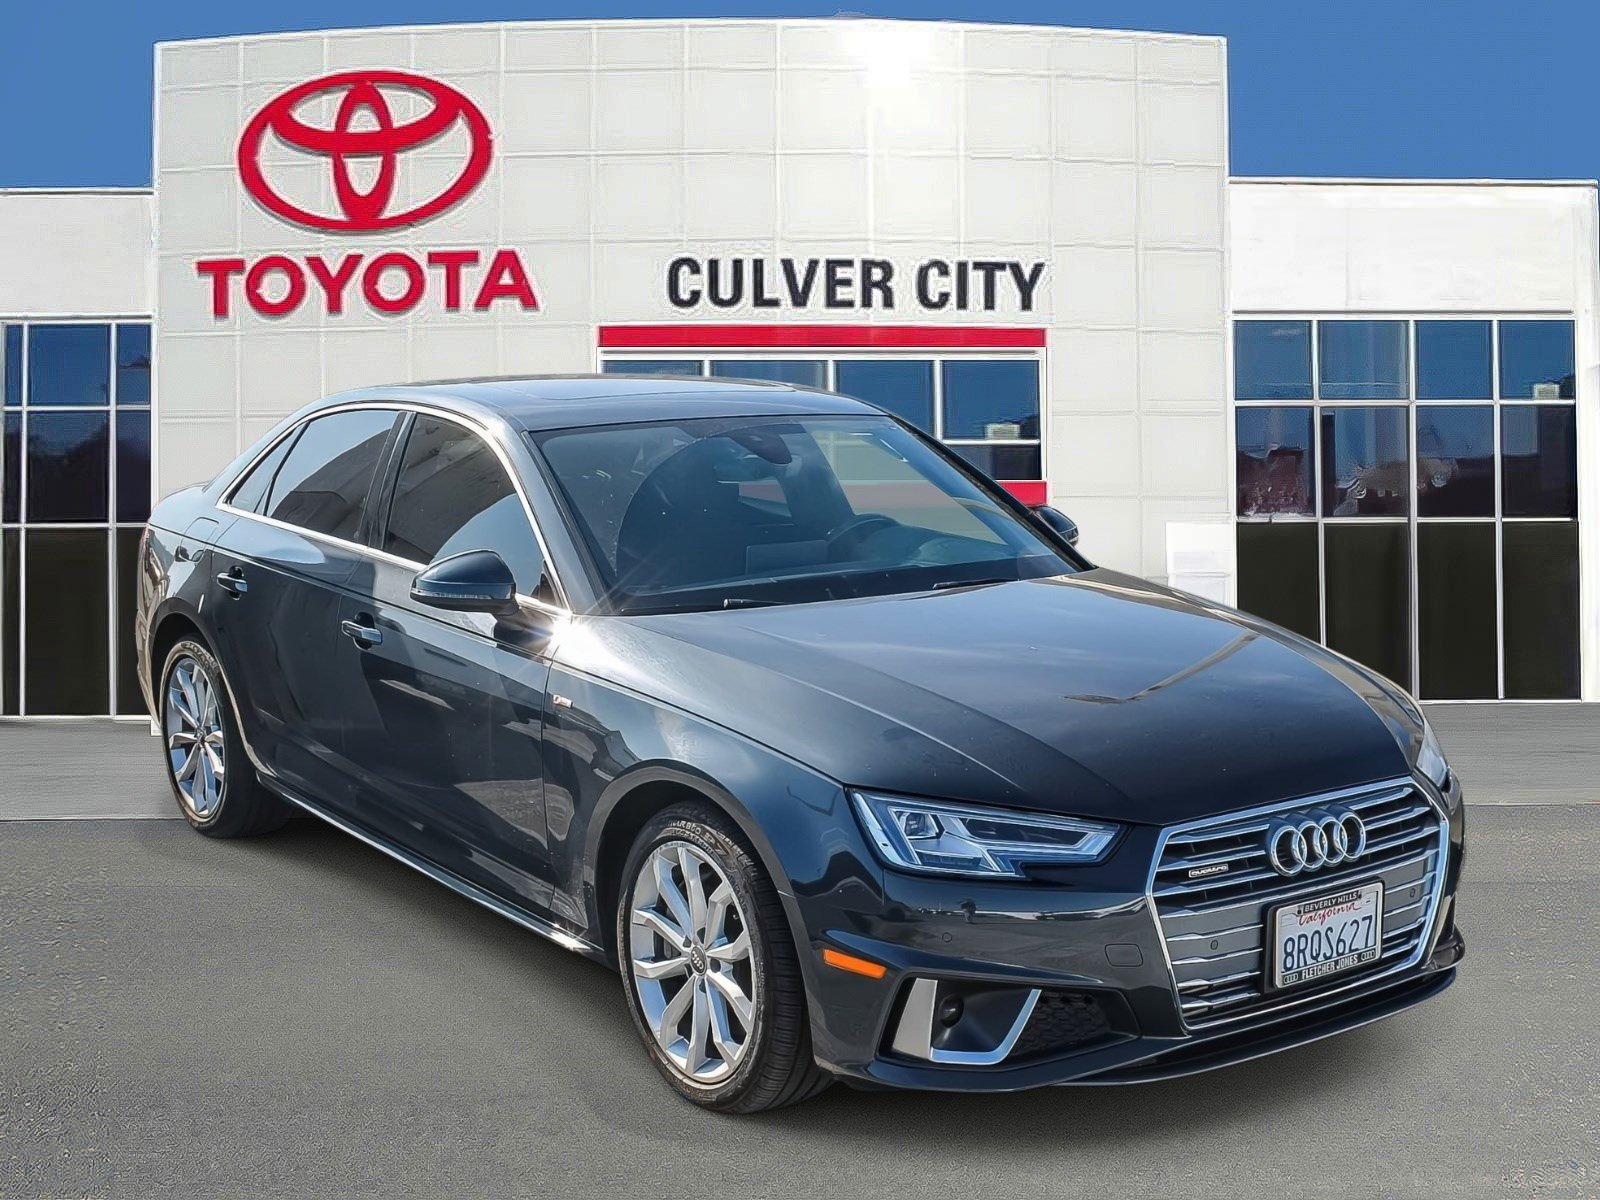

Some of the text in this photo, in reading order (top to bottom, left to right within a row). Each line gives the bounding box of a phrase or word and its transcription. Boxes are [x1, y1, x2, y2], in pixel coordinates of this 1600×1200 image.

[196, 249, 539, 318] TOYOTA
[667, 257, 1045, 311] CULVER CITY
[1299, 902, 1361, 926] California
[1304, 891, 1358, 912] BEVERLY HILLS
[1283, 914, 1373, 972] 8RQS627
[1302, 954, 1359, 980] FLETCHER JONES
